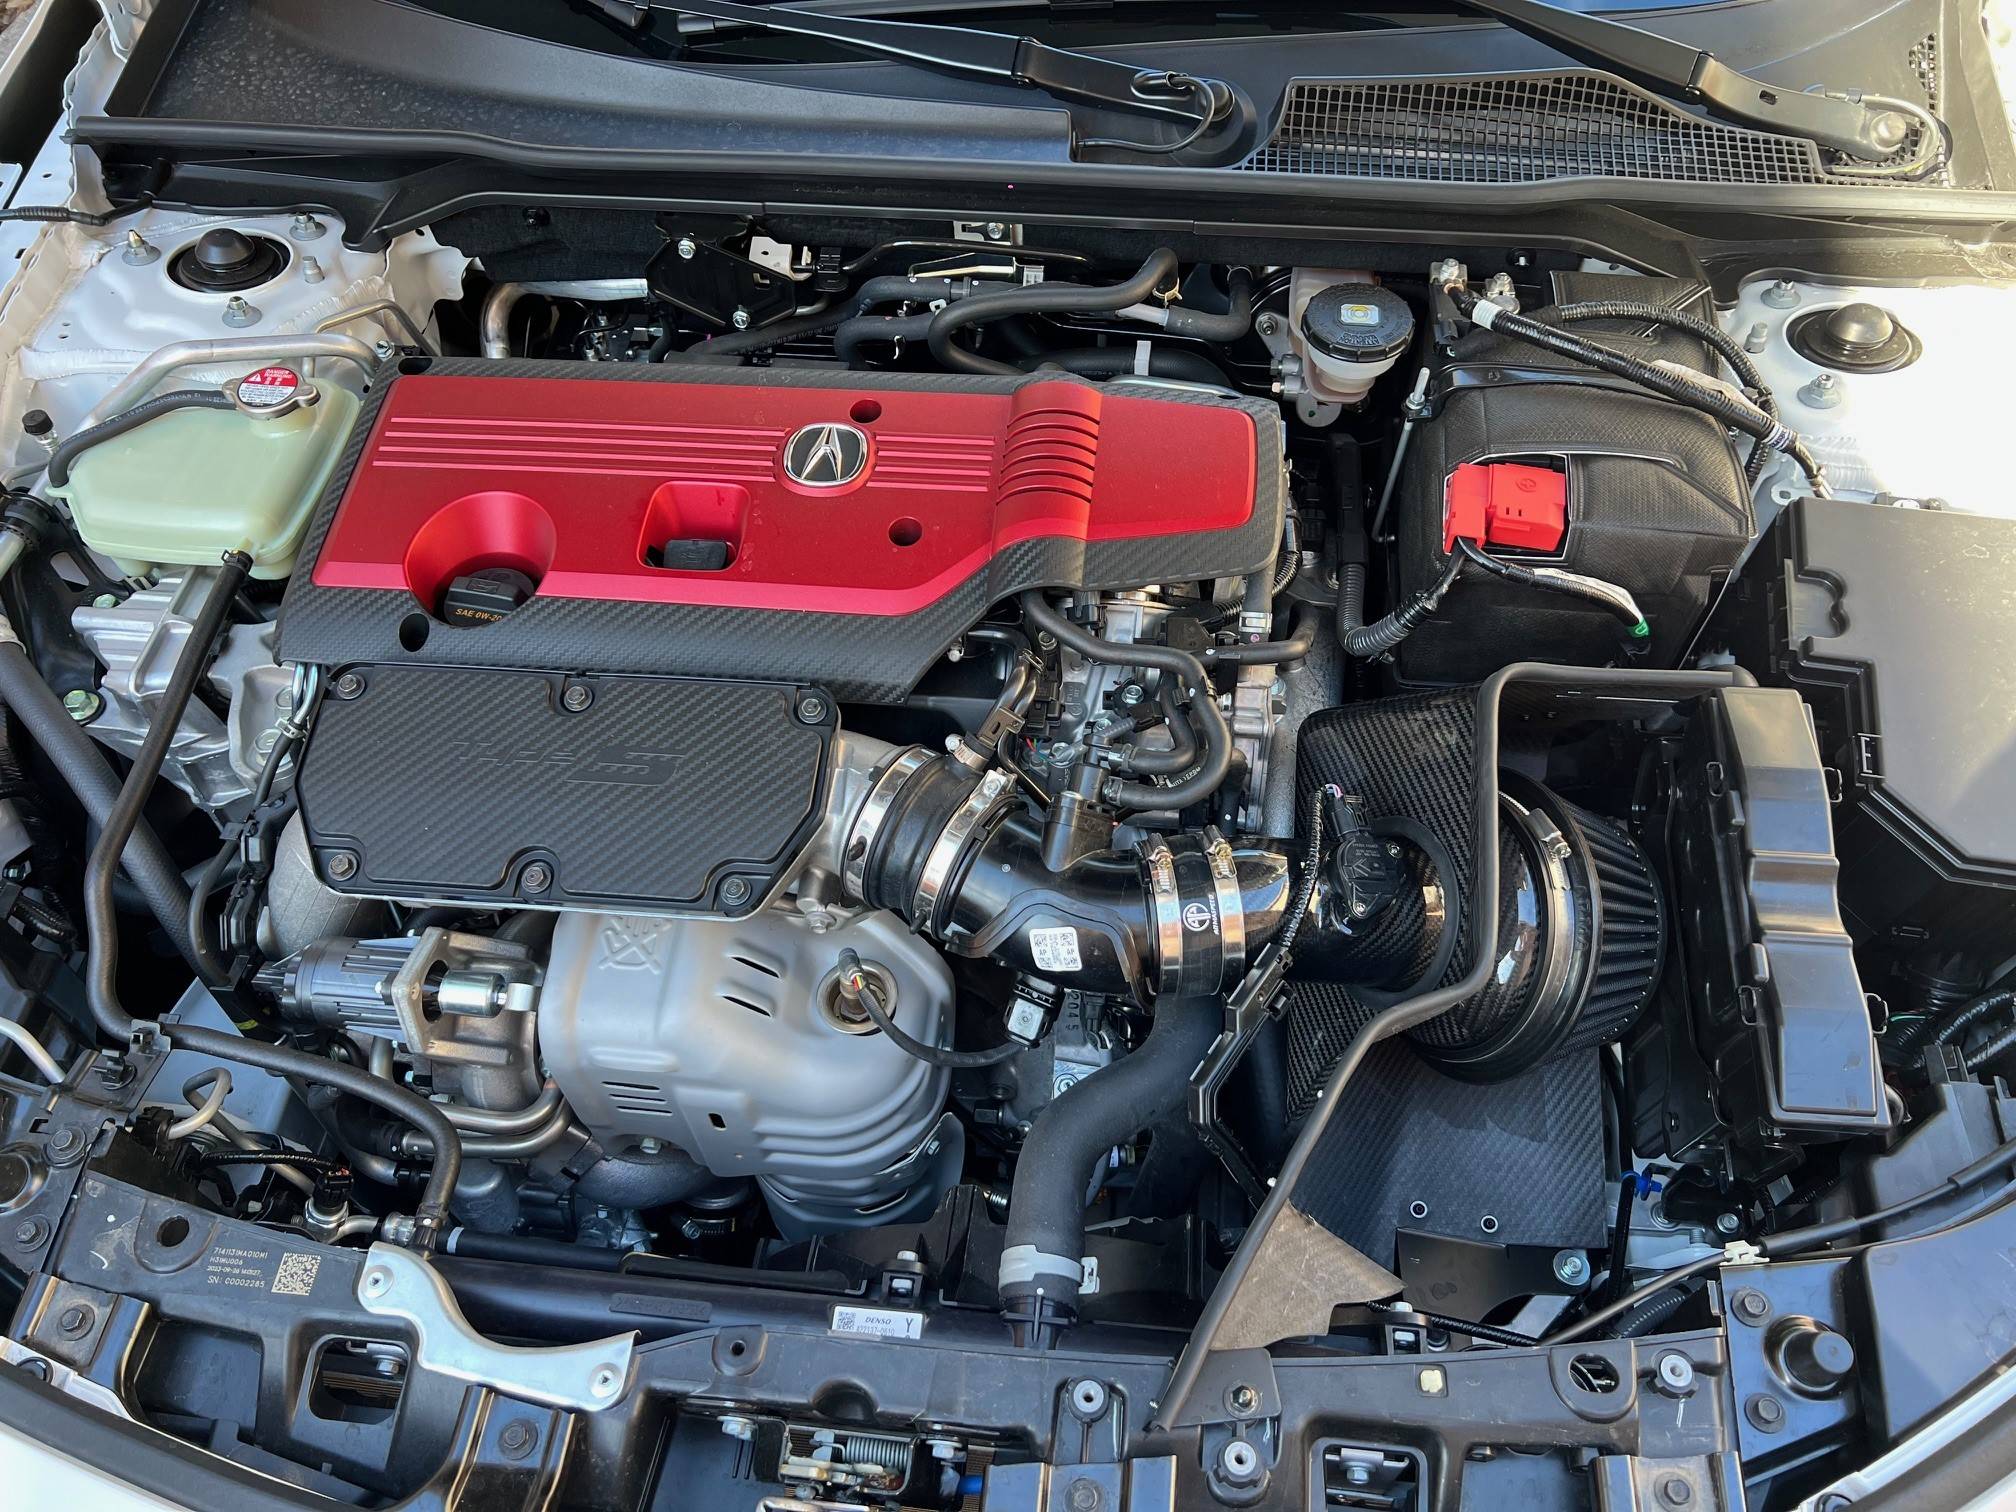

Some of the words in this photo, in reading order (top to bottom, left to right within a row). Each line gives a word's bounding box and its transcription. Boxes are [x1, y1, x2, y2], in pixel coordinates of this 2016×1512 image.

[455, 608, 475, 617] SAE
[865, 1316, 892, 1325] DENSO
[905, 1317, 915, 1333] Y
